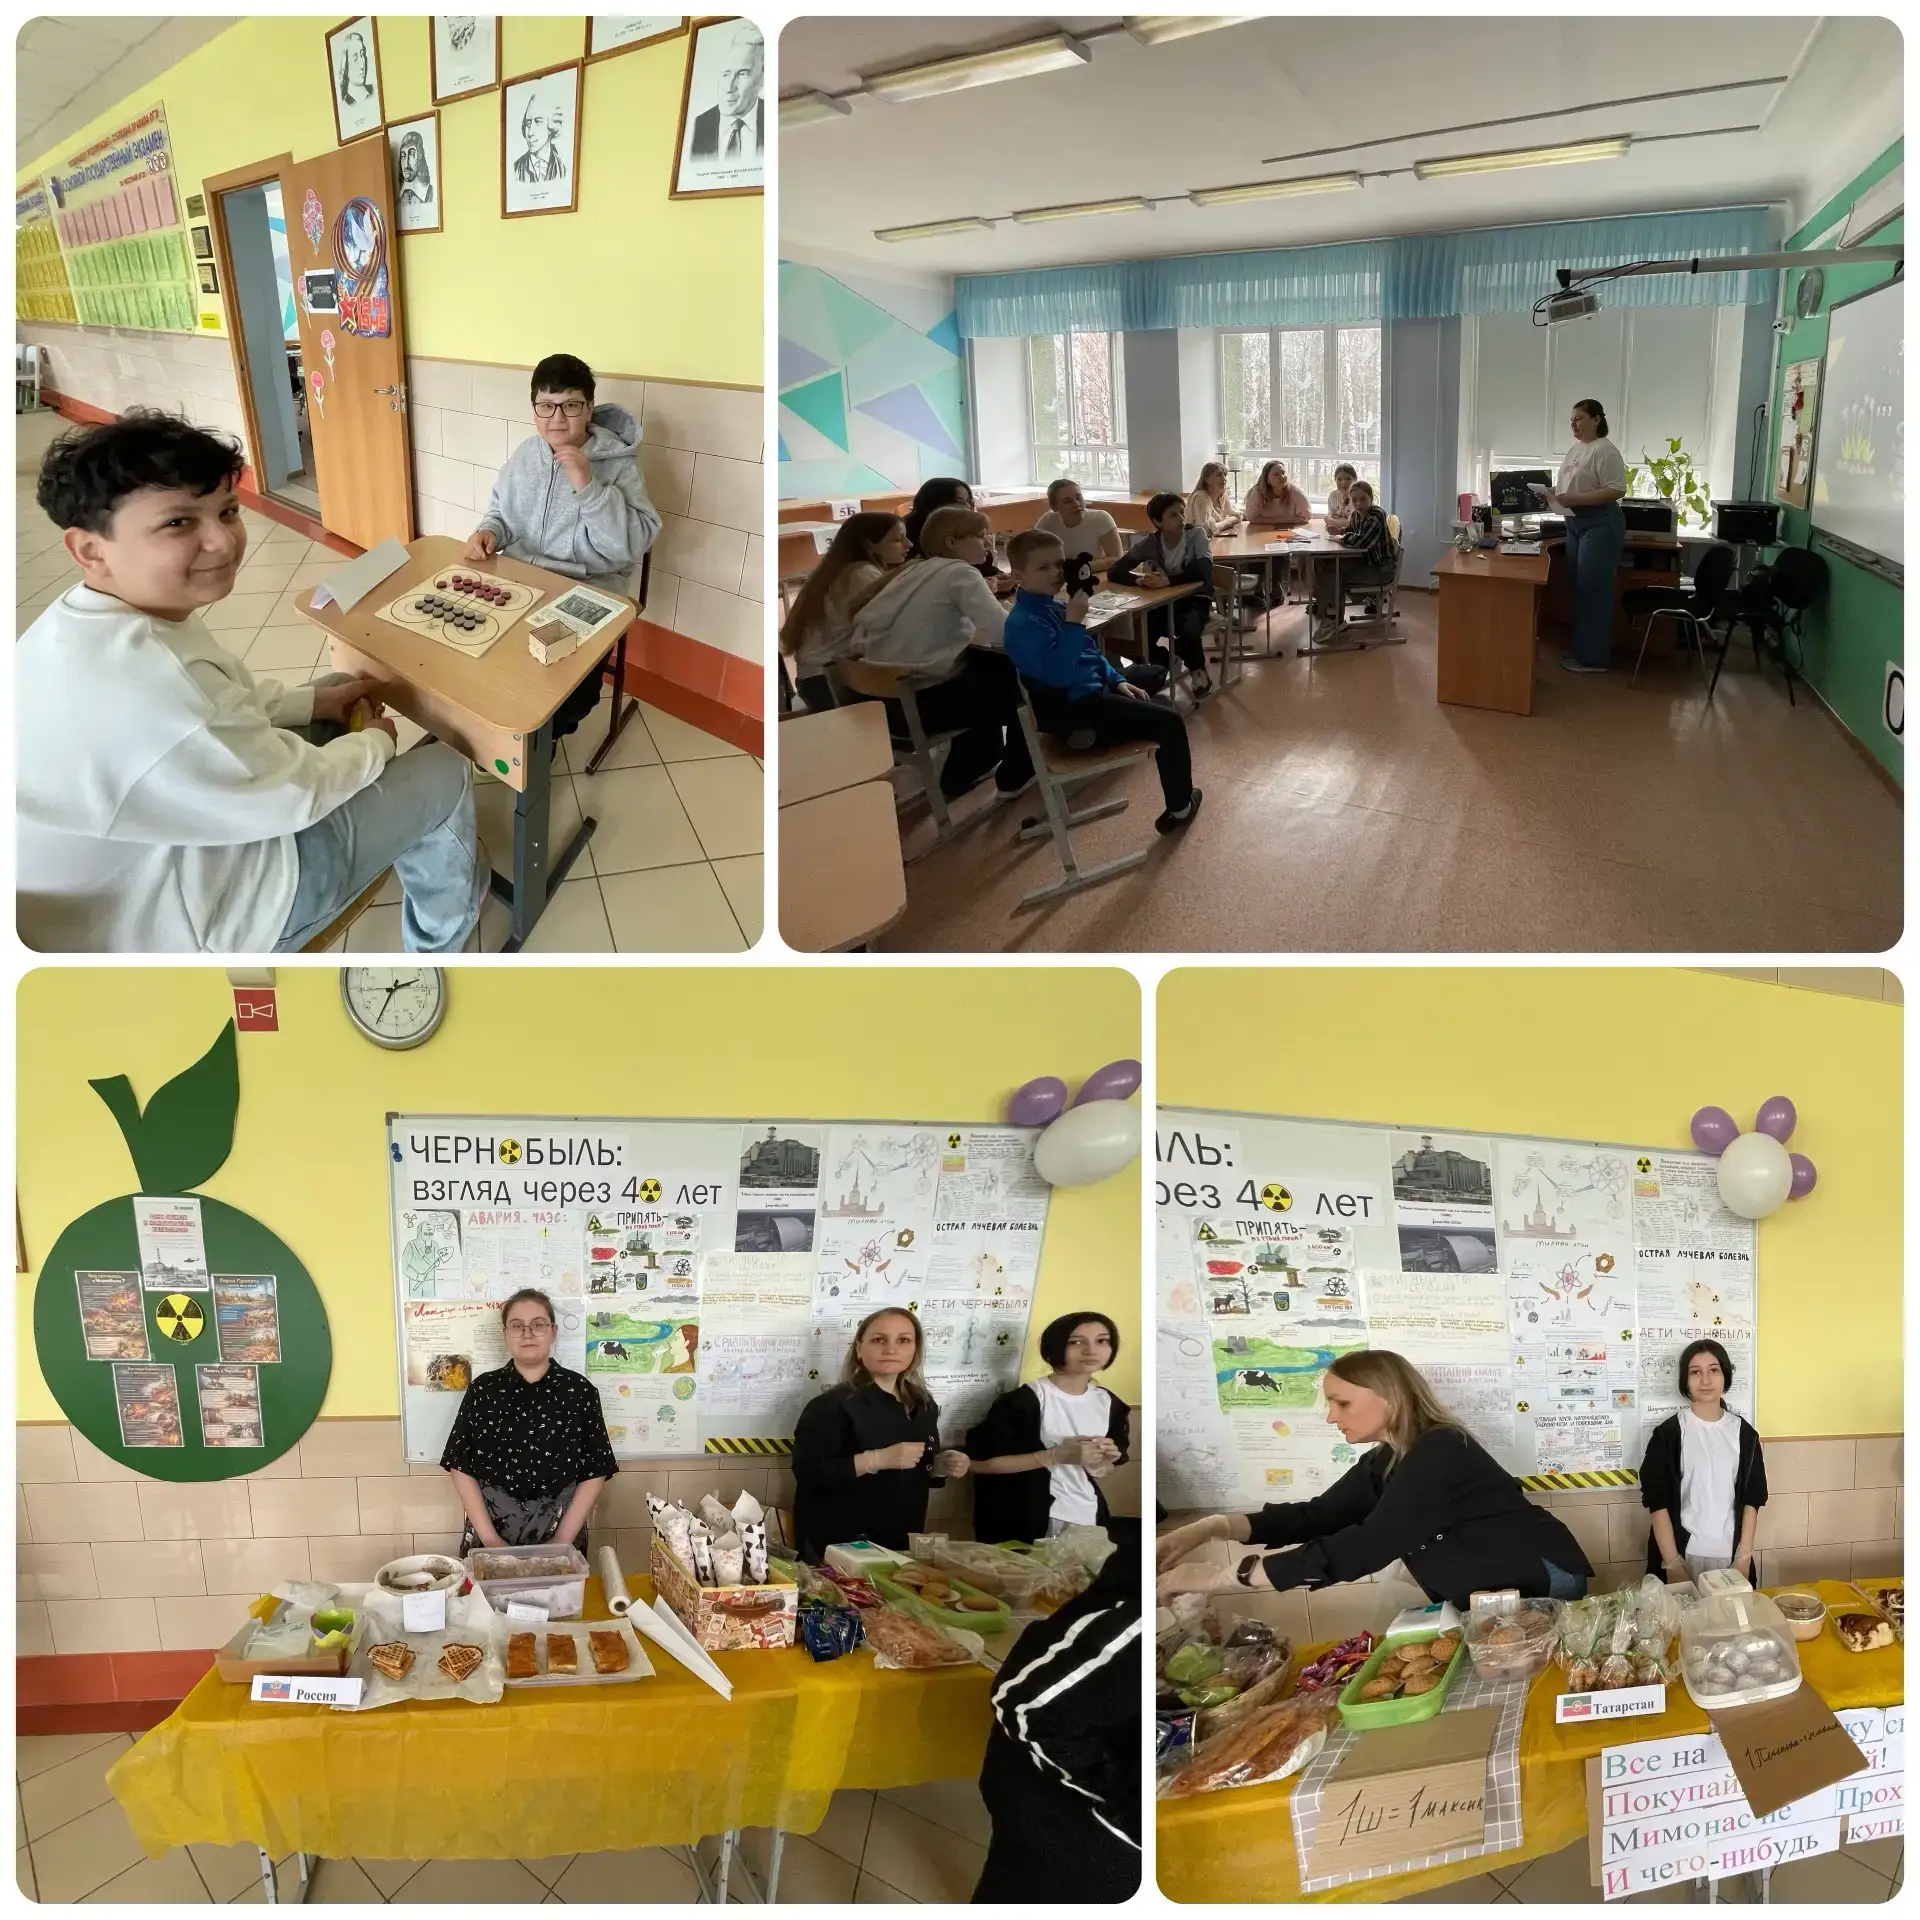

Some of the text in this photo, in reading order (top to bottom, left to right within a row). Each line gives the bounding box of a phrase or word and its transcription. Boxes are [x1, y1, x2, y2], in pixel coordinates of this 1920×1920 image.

[132, 129, 165, 160] ЭКЗАМЕН
[413, 1180, 512, 1206] взгляд
[524, 1180, 612, 1208] через
[676, 1184, 723, 1206] лет
[1315, 1192, 1374, 1218] лет
[936, 1222, 966, 1231] ОСТРАЯ
[1009, 1222, 1039, 1231] БОЛЕЗНЬ
[1638, 1249, 1750, 1262] ОСТРАЯ ЛУЧЕВАЯ БОЛЕЗНЬ
[924, 1299, 955, 1309] ДЕТИ
[1639, 1327, 1674, 1338] ДЕТИ
[296, 1688, 337, 1702] Россия
[1593, 1700, 1655, 1715] Татарстан
[1603, 1751, 1662, 1780] Все
[1672, 1747, 1707, 1769] на
[1605, 1867, 1631, 1896] И
